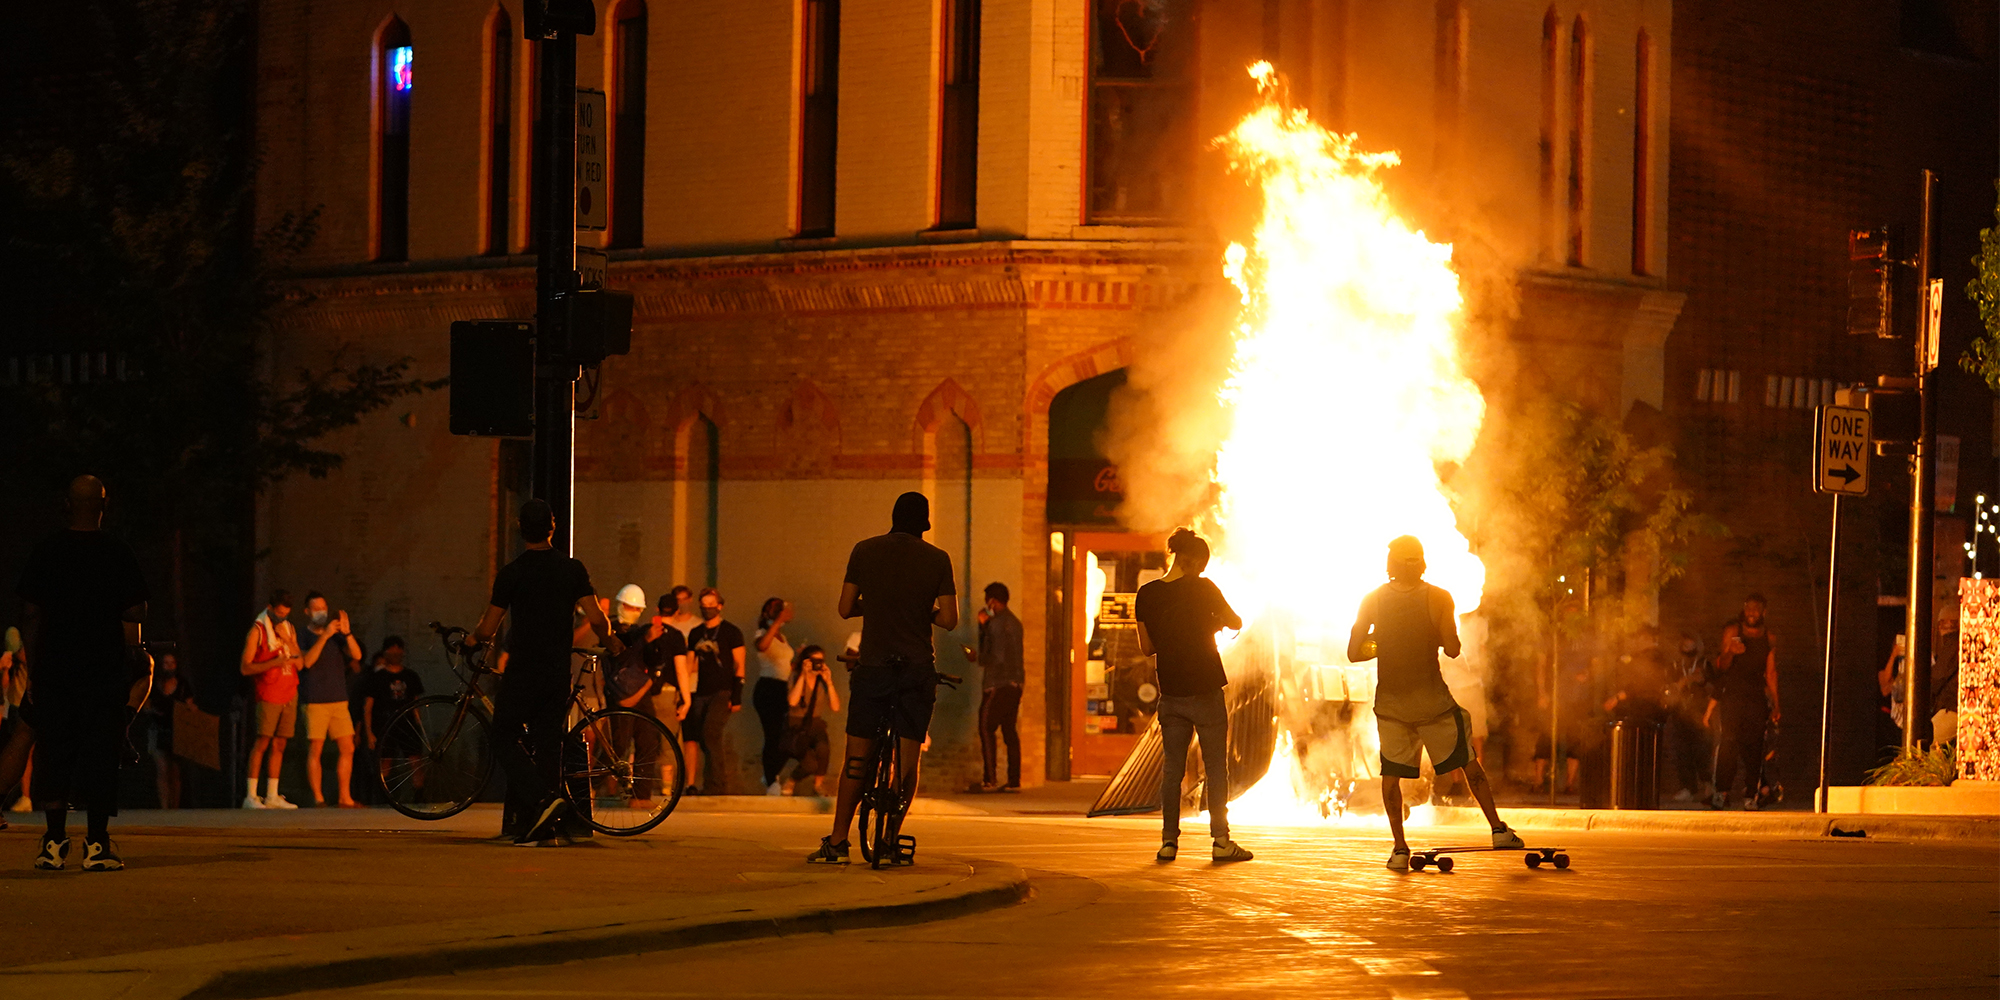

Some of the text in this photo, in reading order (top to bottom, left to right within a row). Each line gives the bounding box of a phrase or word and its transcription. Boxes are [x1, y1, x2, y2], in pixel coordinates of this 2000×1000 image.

[579, 102, 593, 128] NO
[586, 161, 602, 182] RED
[1831, 415, 1864, 437] ONE
[1829, 439, 1864, 461] WAY
